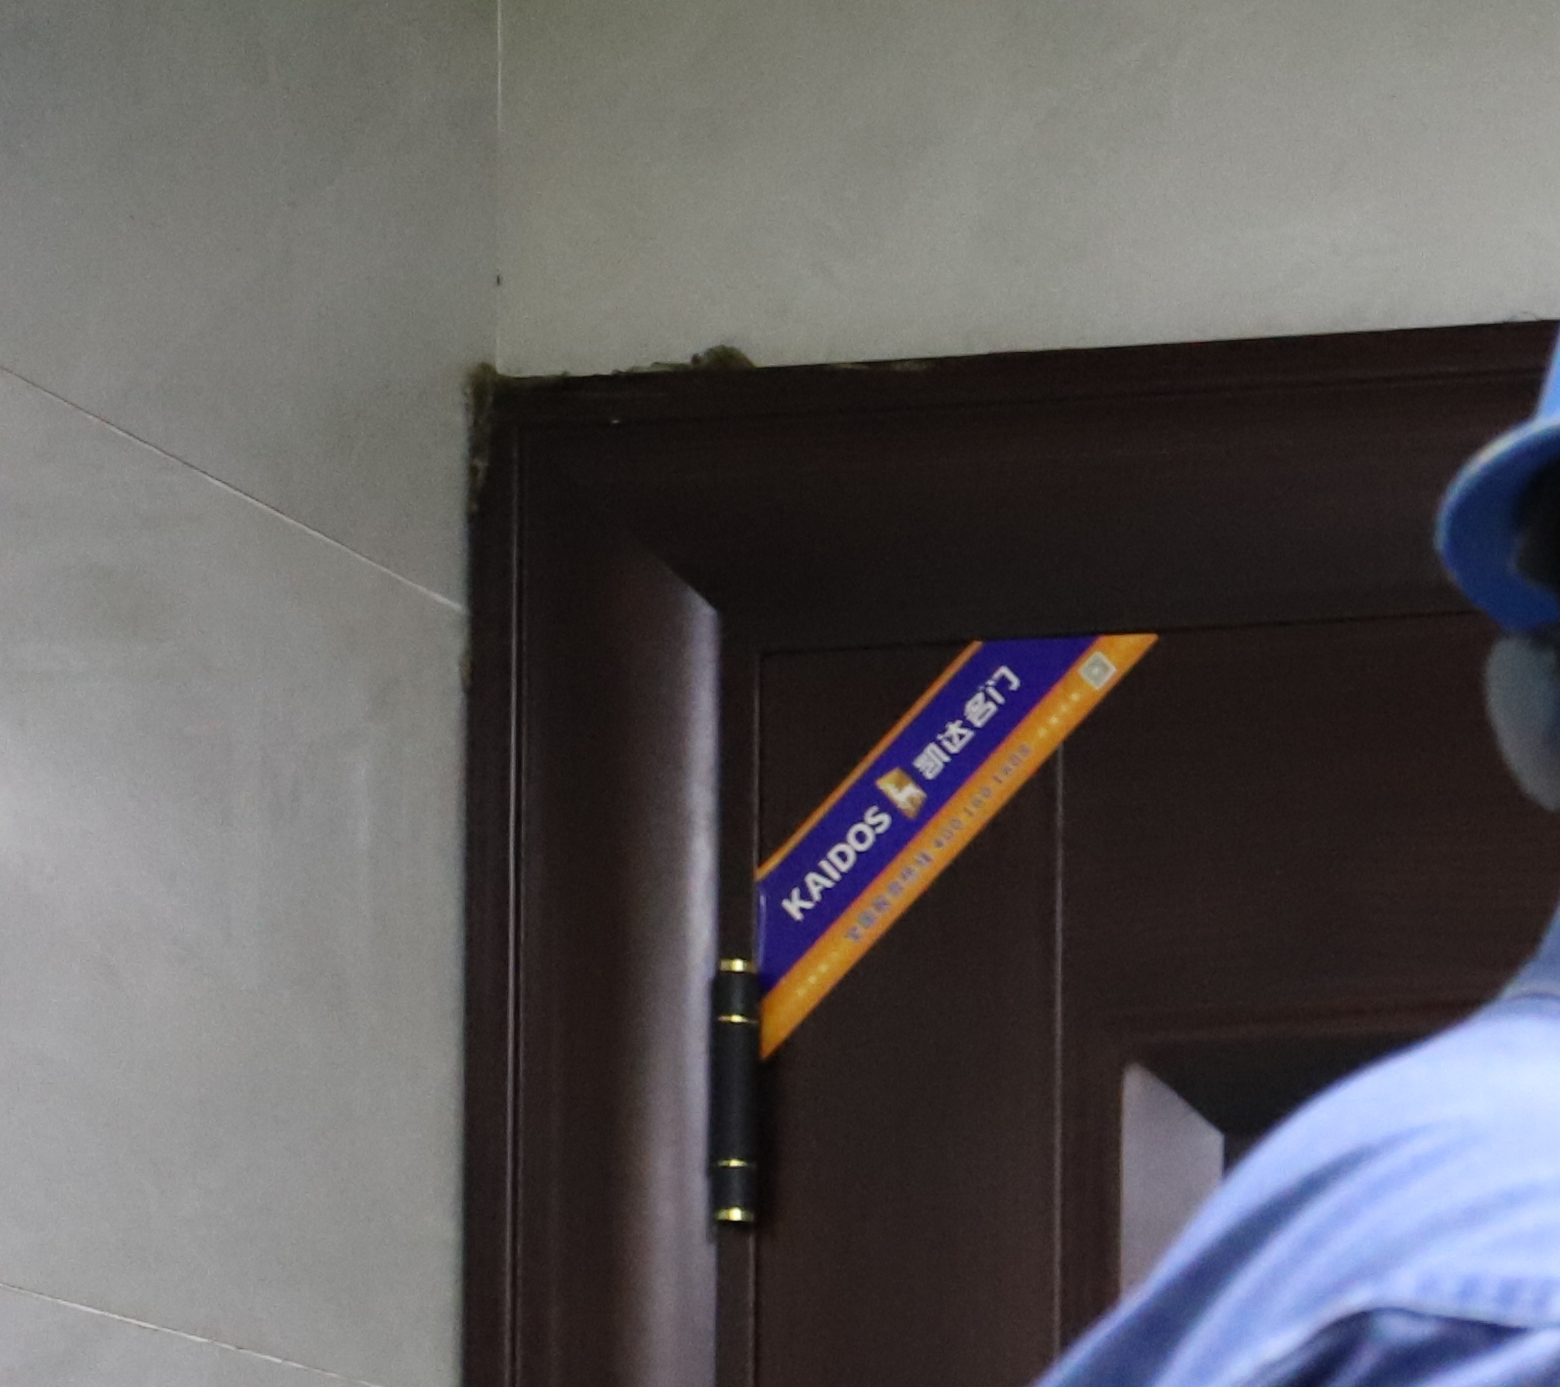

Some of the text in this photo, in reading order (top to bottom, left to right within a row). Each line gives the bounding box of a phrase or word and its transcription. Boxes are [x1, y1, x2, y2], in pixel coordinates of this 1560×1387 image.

[912, 665, 1021, 780] 凯达名门
[781, 805, 893, 921] KAIDOS
